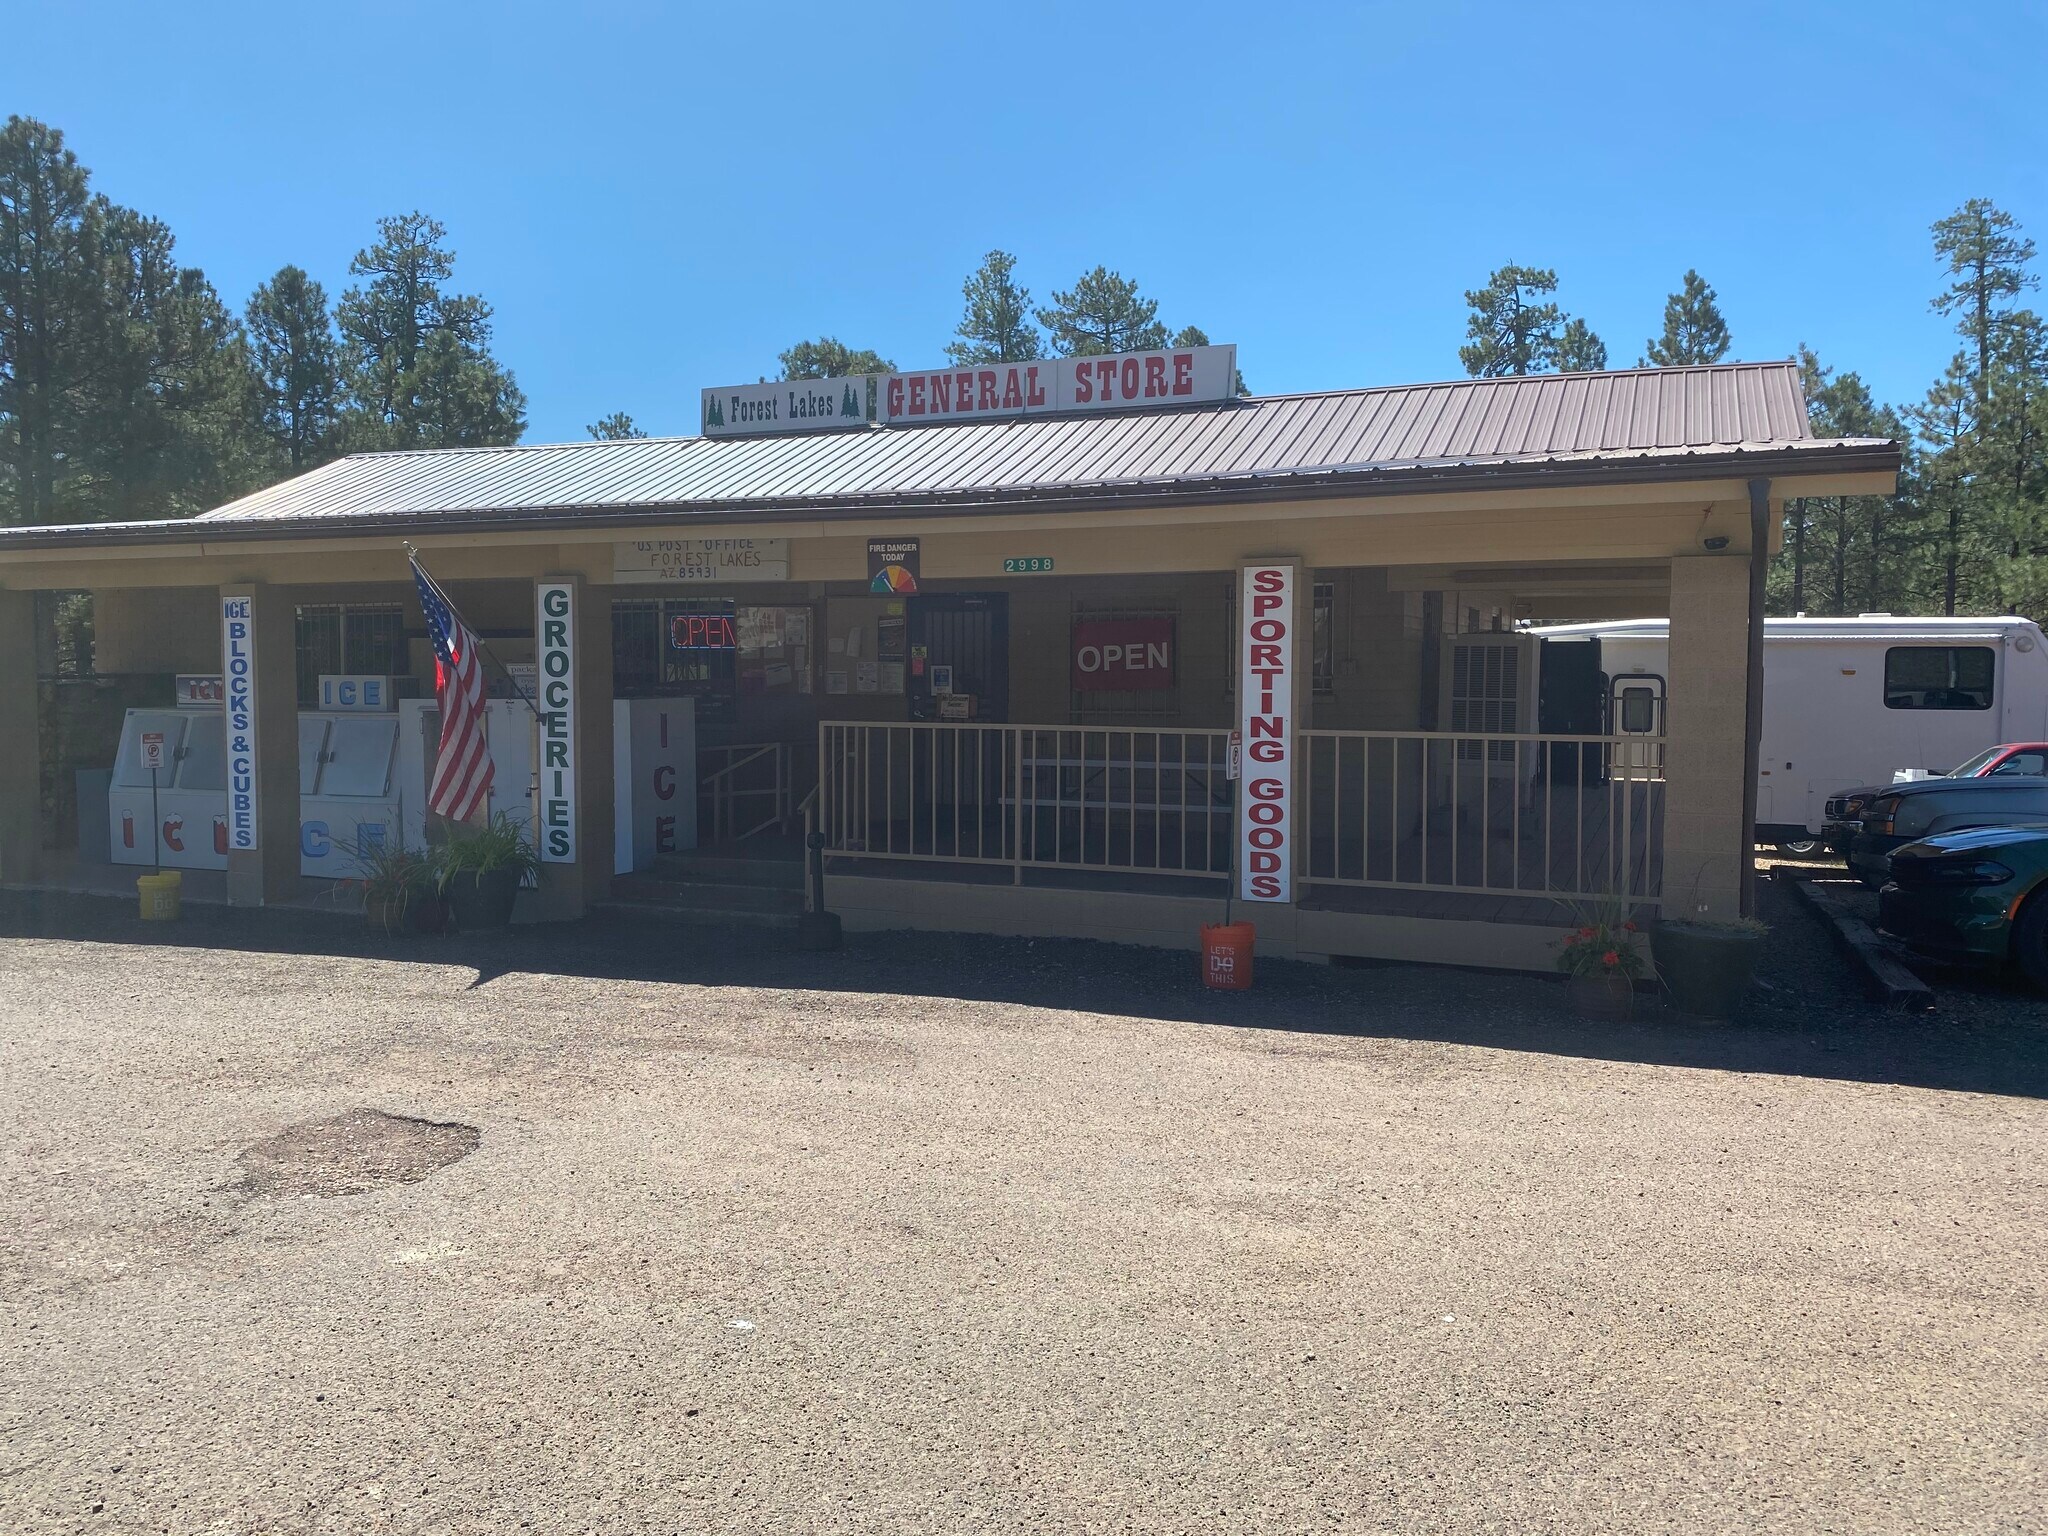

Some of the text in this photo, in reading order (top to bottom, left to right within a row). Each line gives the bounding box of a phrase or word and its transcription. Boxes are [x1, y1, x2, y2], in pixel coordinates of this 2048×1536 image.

[886, 353, 1194, 418] GENERAL STORE
[731, 391, 834, 422] Forest Lakes
[650, 551, 762, 567] FOREST LAKES
[658, 540, 690, 552] POST
[705, 539, 755, 551] OFFICE
[869, 542, 918, 553] FIRE DANGER
[881, 553, 906, 562] TODAY
[1006, 557, 1052, 572] 2998
[225, 600, 250, 620] ICE
[673, 617, 736, 647] OPEN
[1077, 641, 1169, 673] OPEN
[1250, 569, 1286, 764] SPORTING
[228, 622, 248, 732] BLOCKS
[324, 680, 380, 705] ICE
[543, 589, 571, 858] GROCERIES
[233, 734, 250, 753] &
[653, 712, 677, 854] ICE
[233, 757, 252, 848] CUBES
[301, 820, 387, 861] CE
[1248, 777, 1285, 899] GOODS
[1210, 945, 1235, 955] LET'S
[1210, 955, 1234, 972] DO
